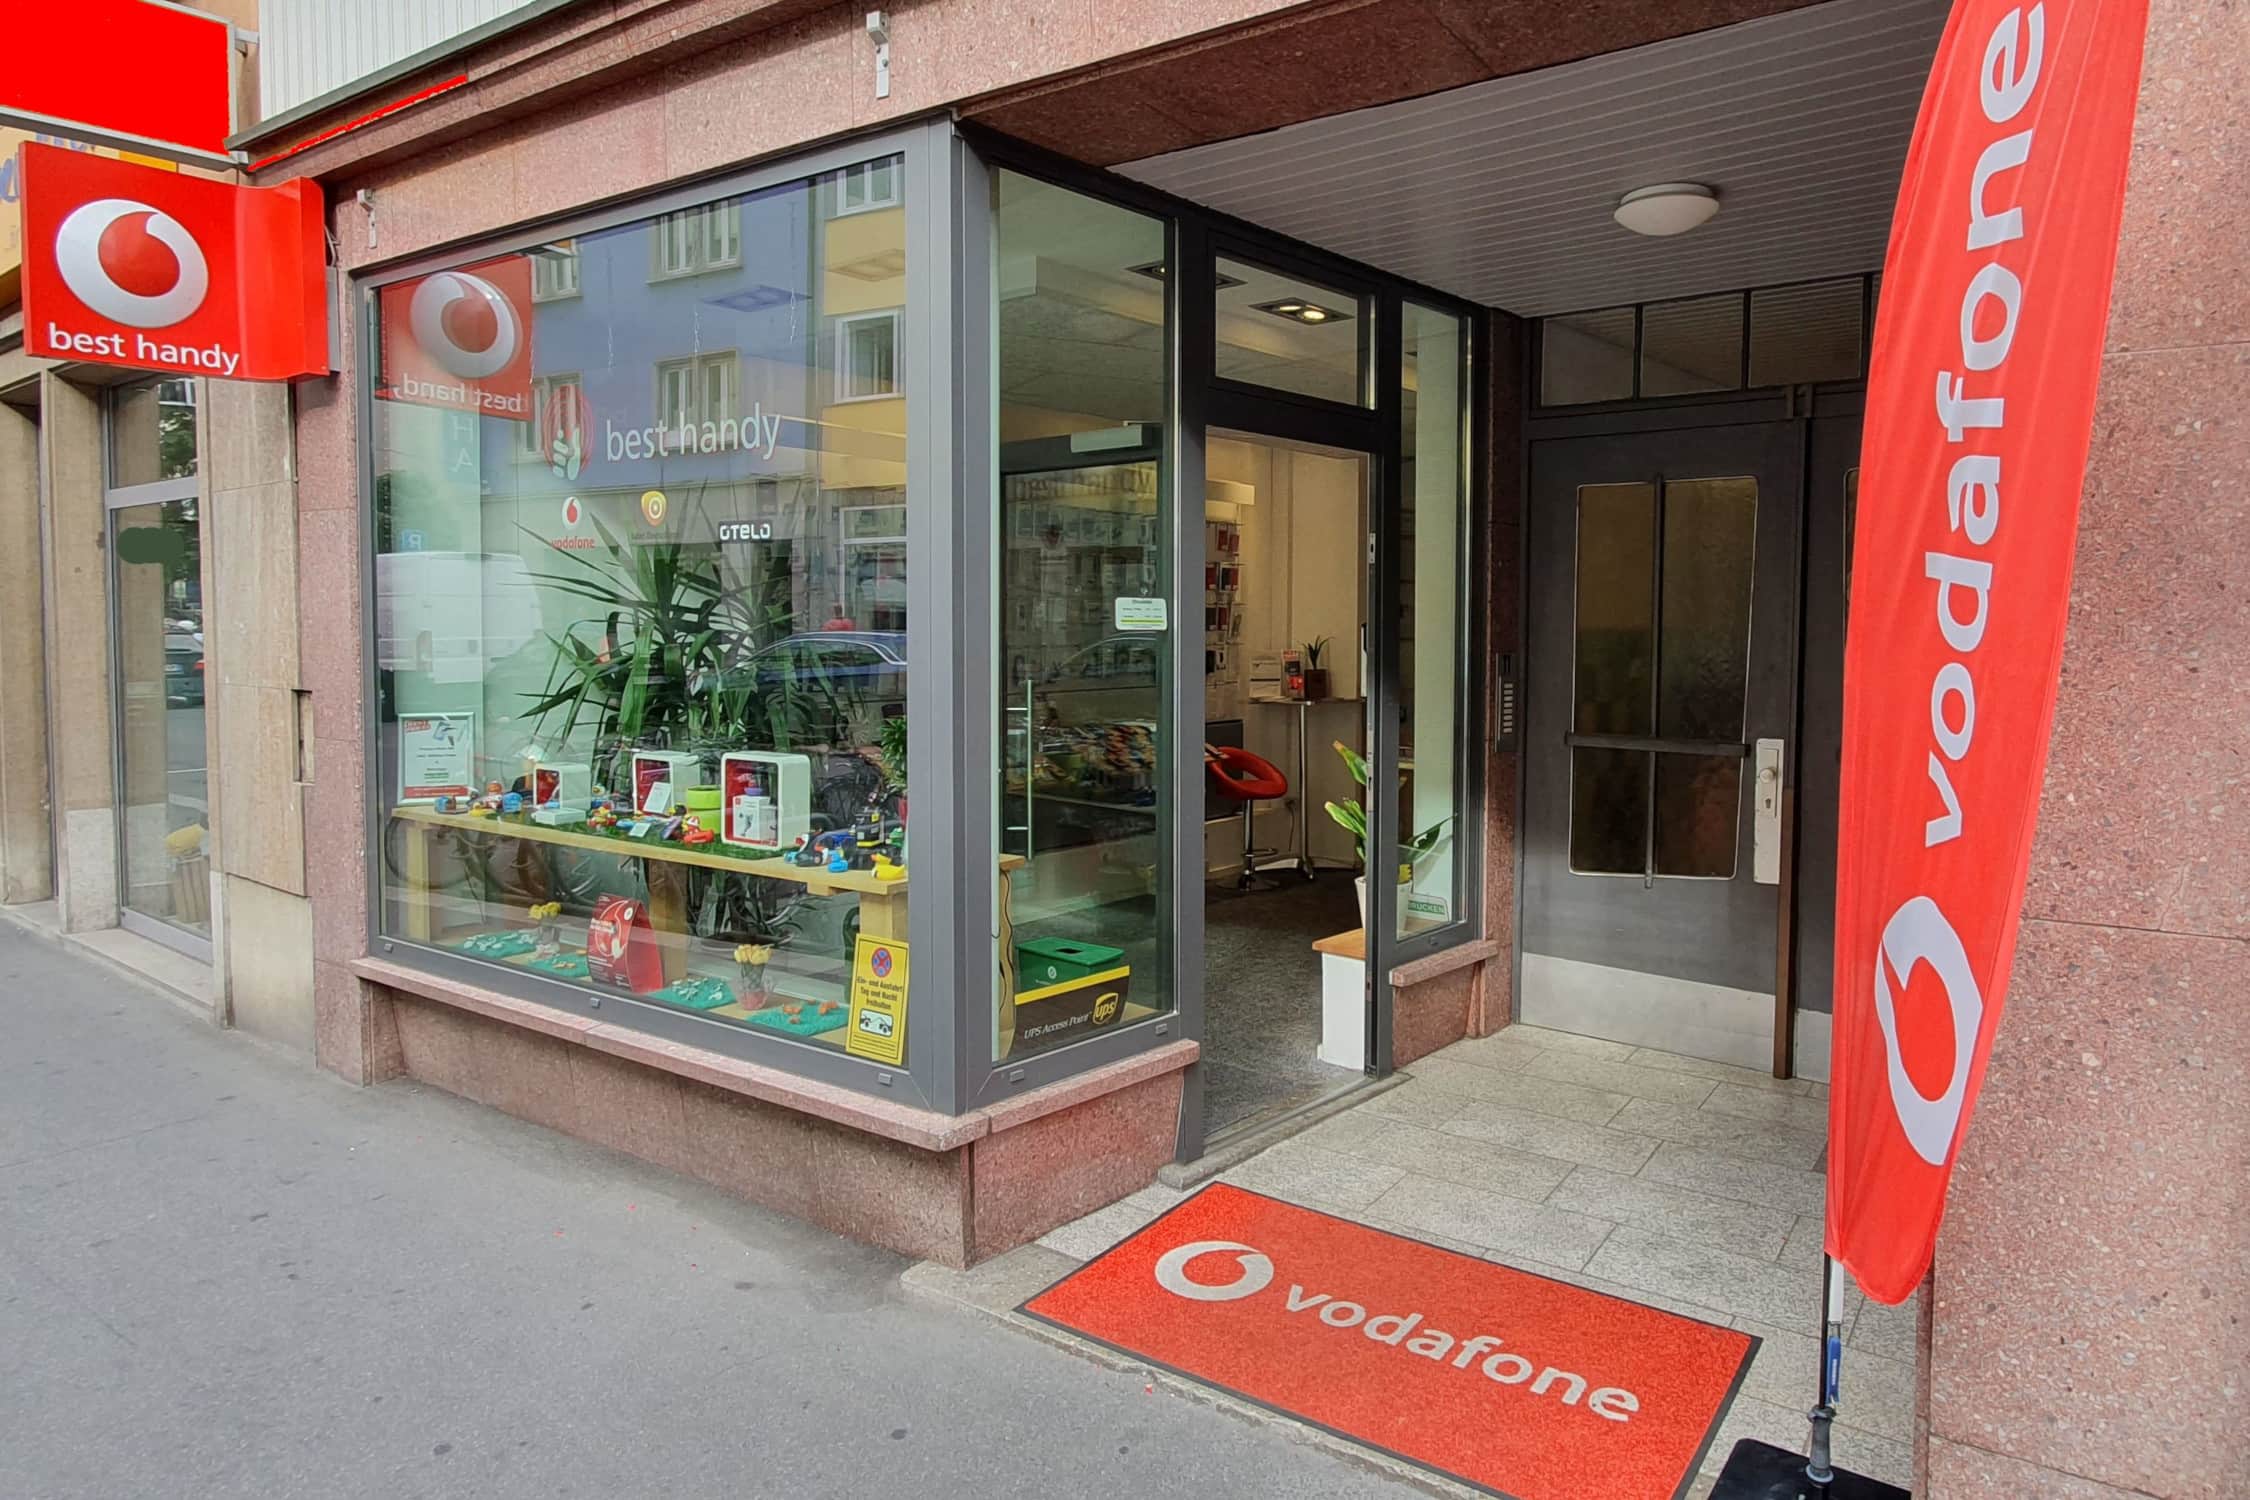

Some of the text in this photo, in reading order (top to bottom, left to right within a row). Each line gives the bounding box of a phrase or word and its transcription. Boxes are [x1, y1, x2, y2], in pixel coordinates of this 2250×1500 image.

[48, 321, 240, 376] best handy
[606, 401, 782, 462] best handy
[1925, 2, 2044, 847] vodafone
[551, 536, 596, 550] vodafone
[1024, 1026, 1042, 1040] UPS
[1042, 1017, 1069, 1034] Access
[1095, 1001, 1116, 1021] ups
[1284, 1283, 1641, 1423] vodafone
